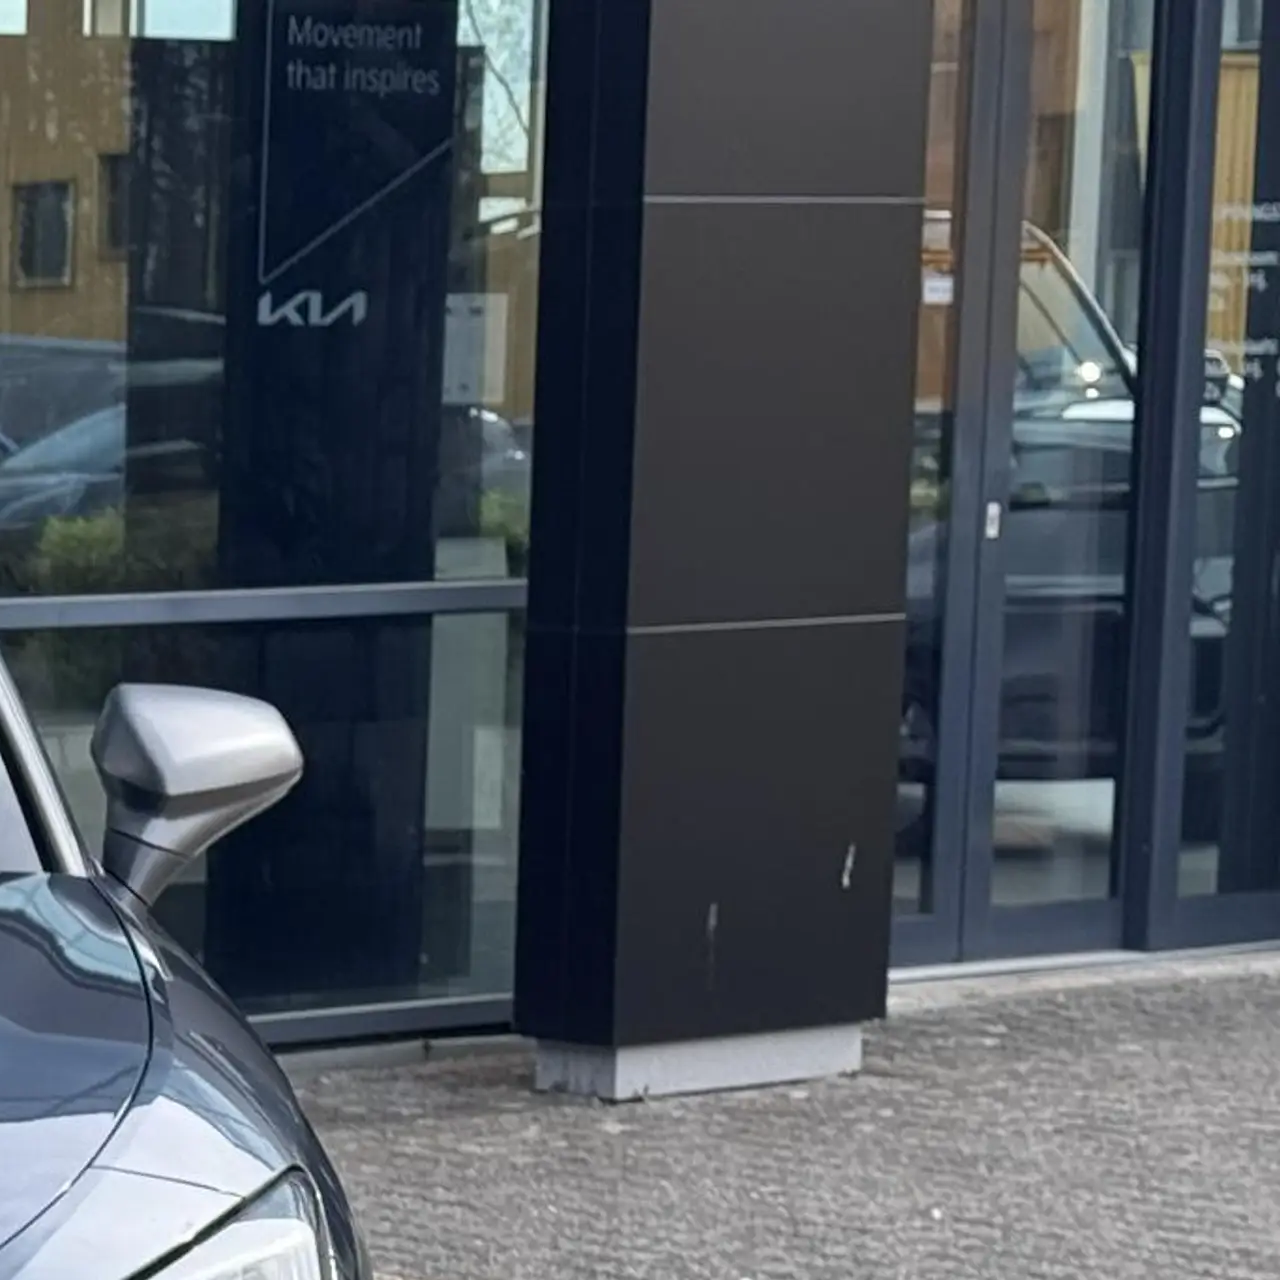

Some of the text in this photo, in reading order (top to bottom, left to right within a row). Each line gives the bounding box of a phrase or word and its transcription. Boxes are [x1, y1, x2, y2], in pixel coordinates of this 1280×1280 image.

[288, 15, 422, 48] Movement
[287, 60, 439, 97] that inspires
